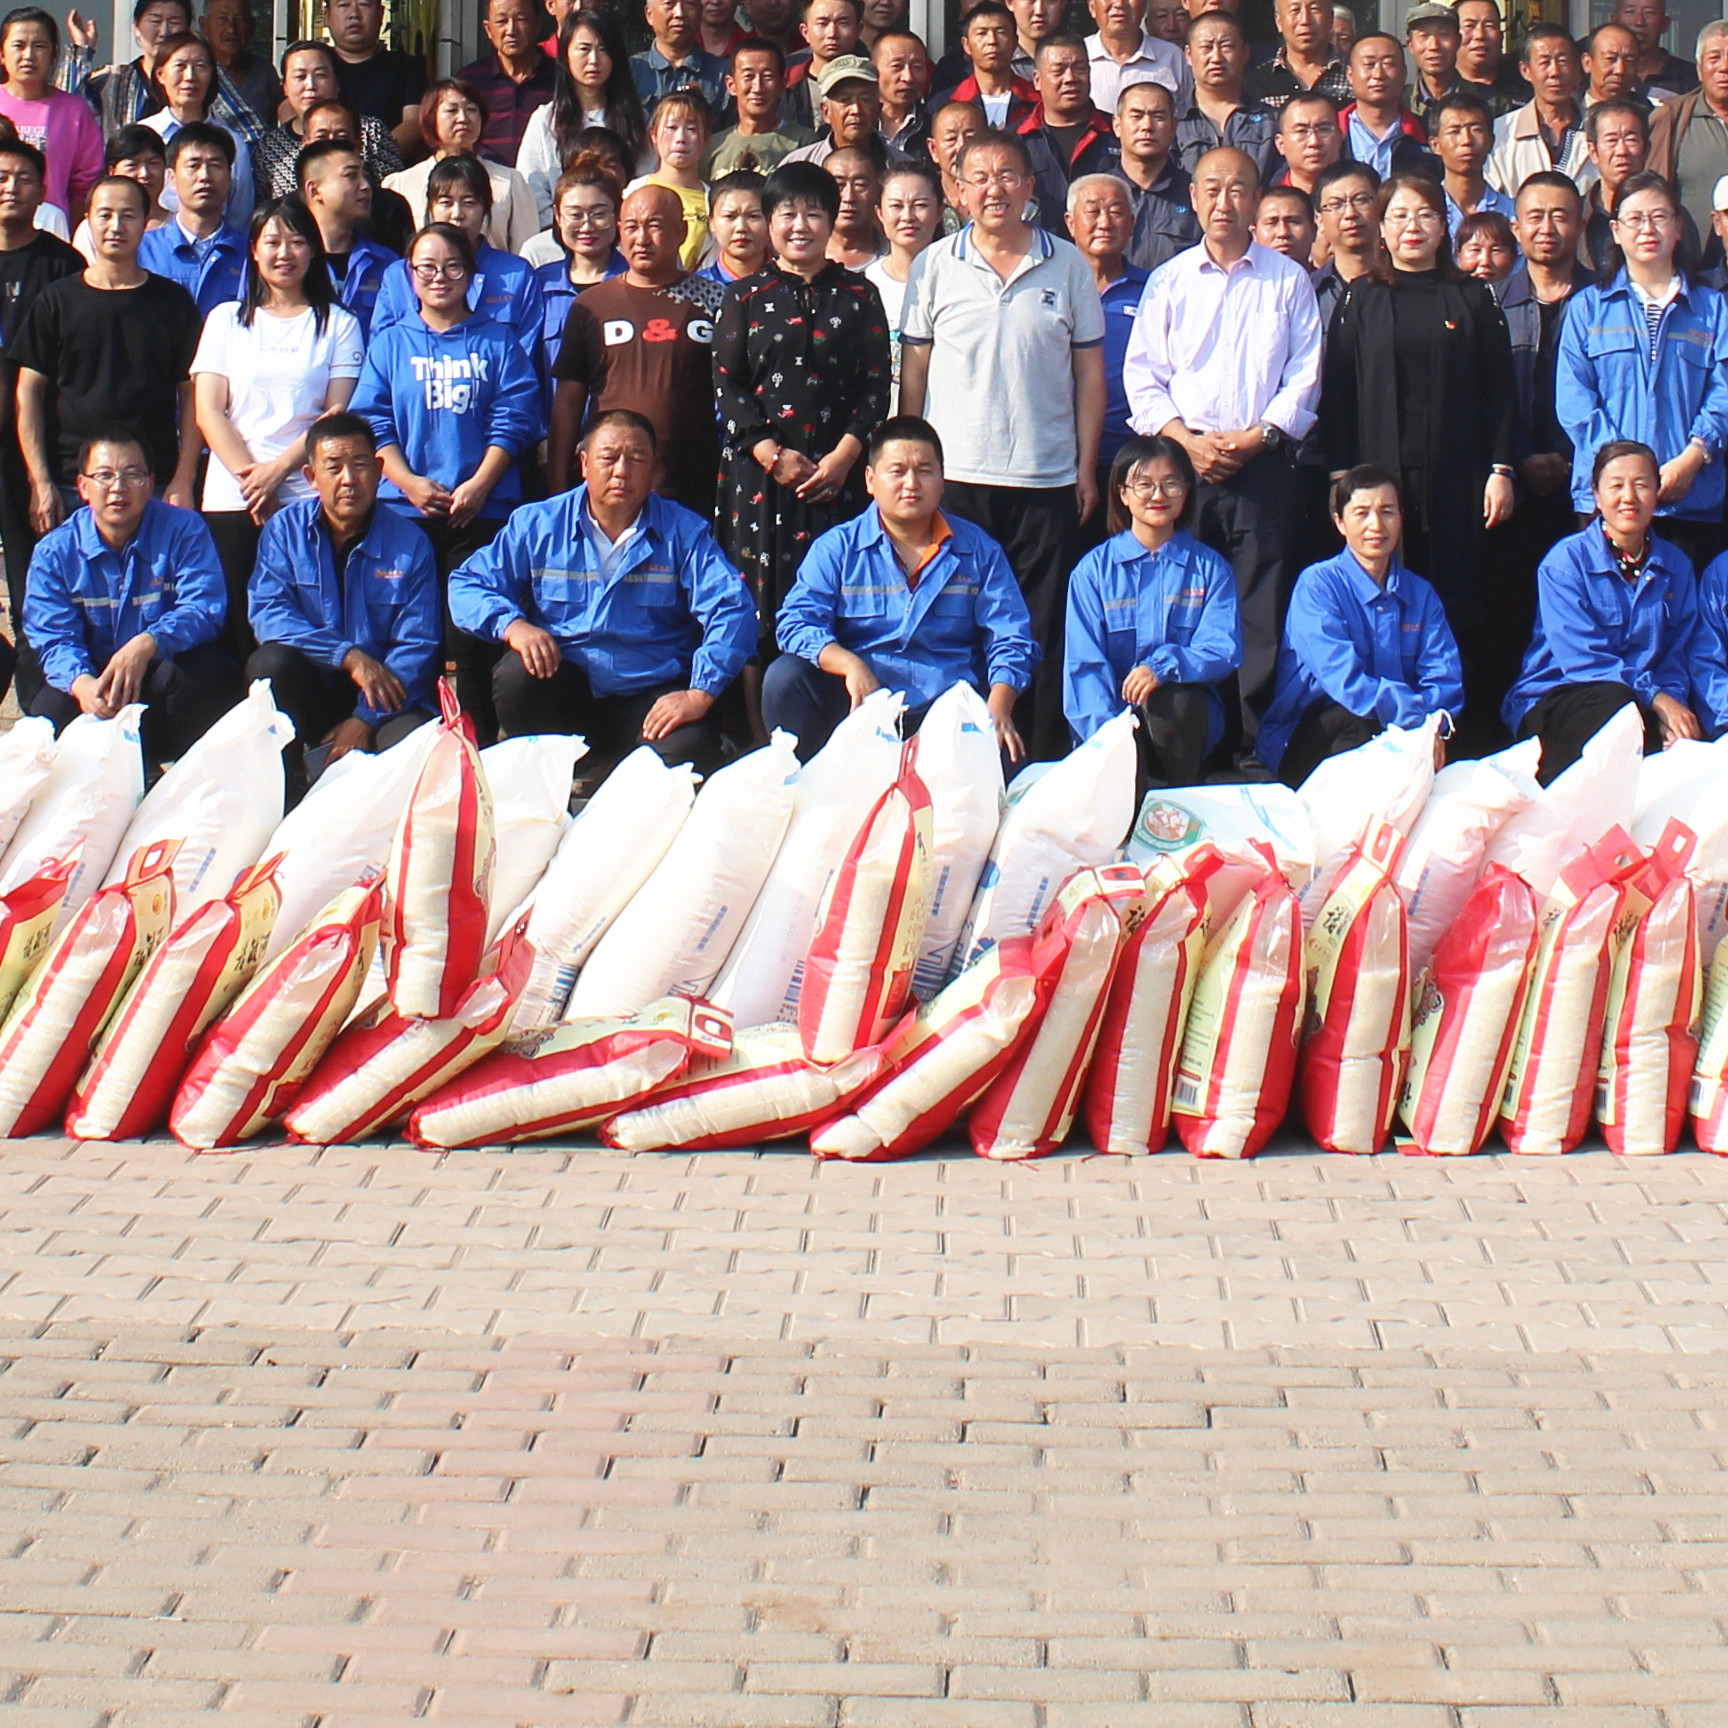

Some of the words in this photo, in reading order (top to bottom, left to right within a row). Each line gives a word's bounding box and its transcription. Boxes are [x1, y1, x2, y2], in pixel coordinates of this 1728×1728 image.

[604, 320, 634, 346] D
[642, 318, 678, 342] &
[687, 319, 714, 343] G
[410, 352, 488, 382] Think
